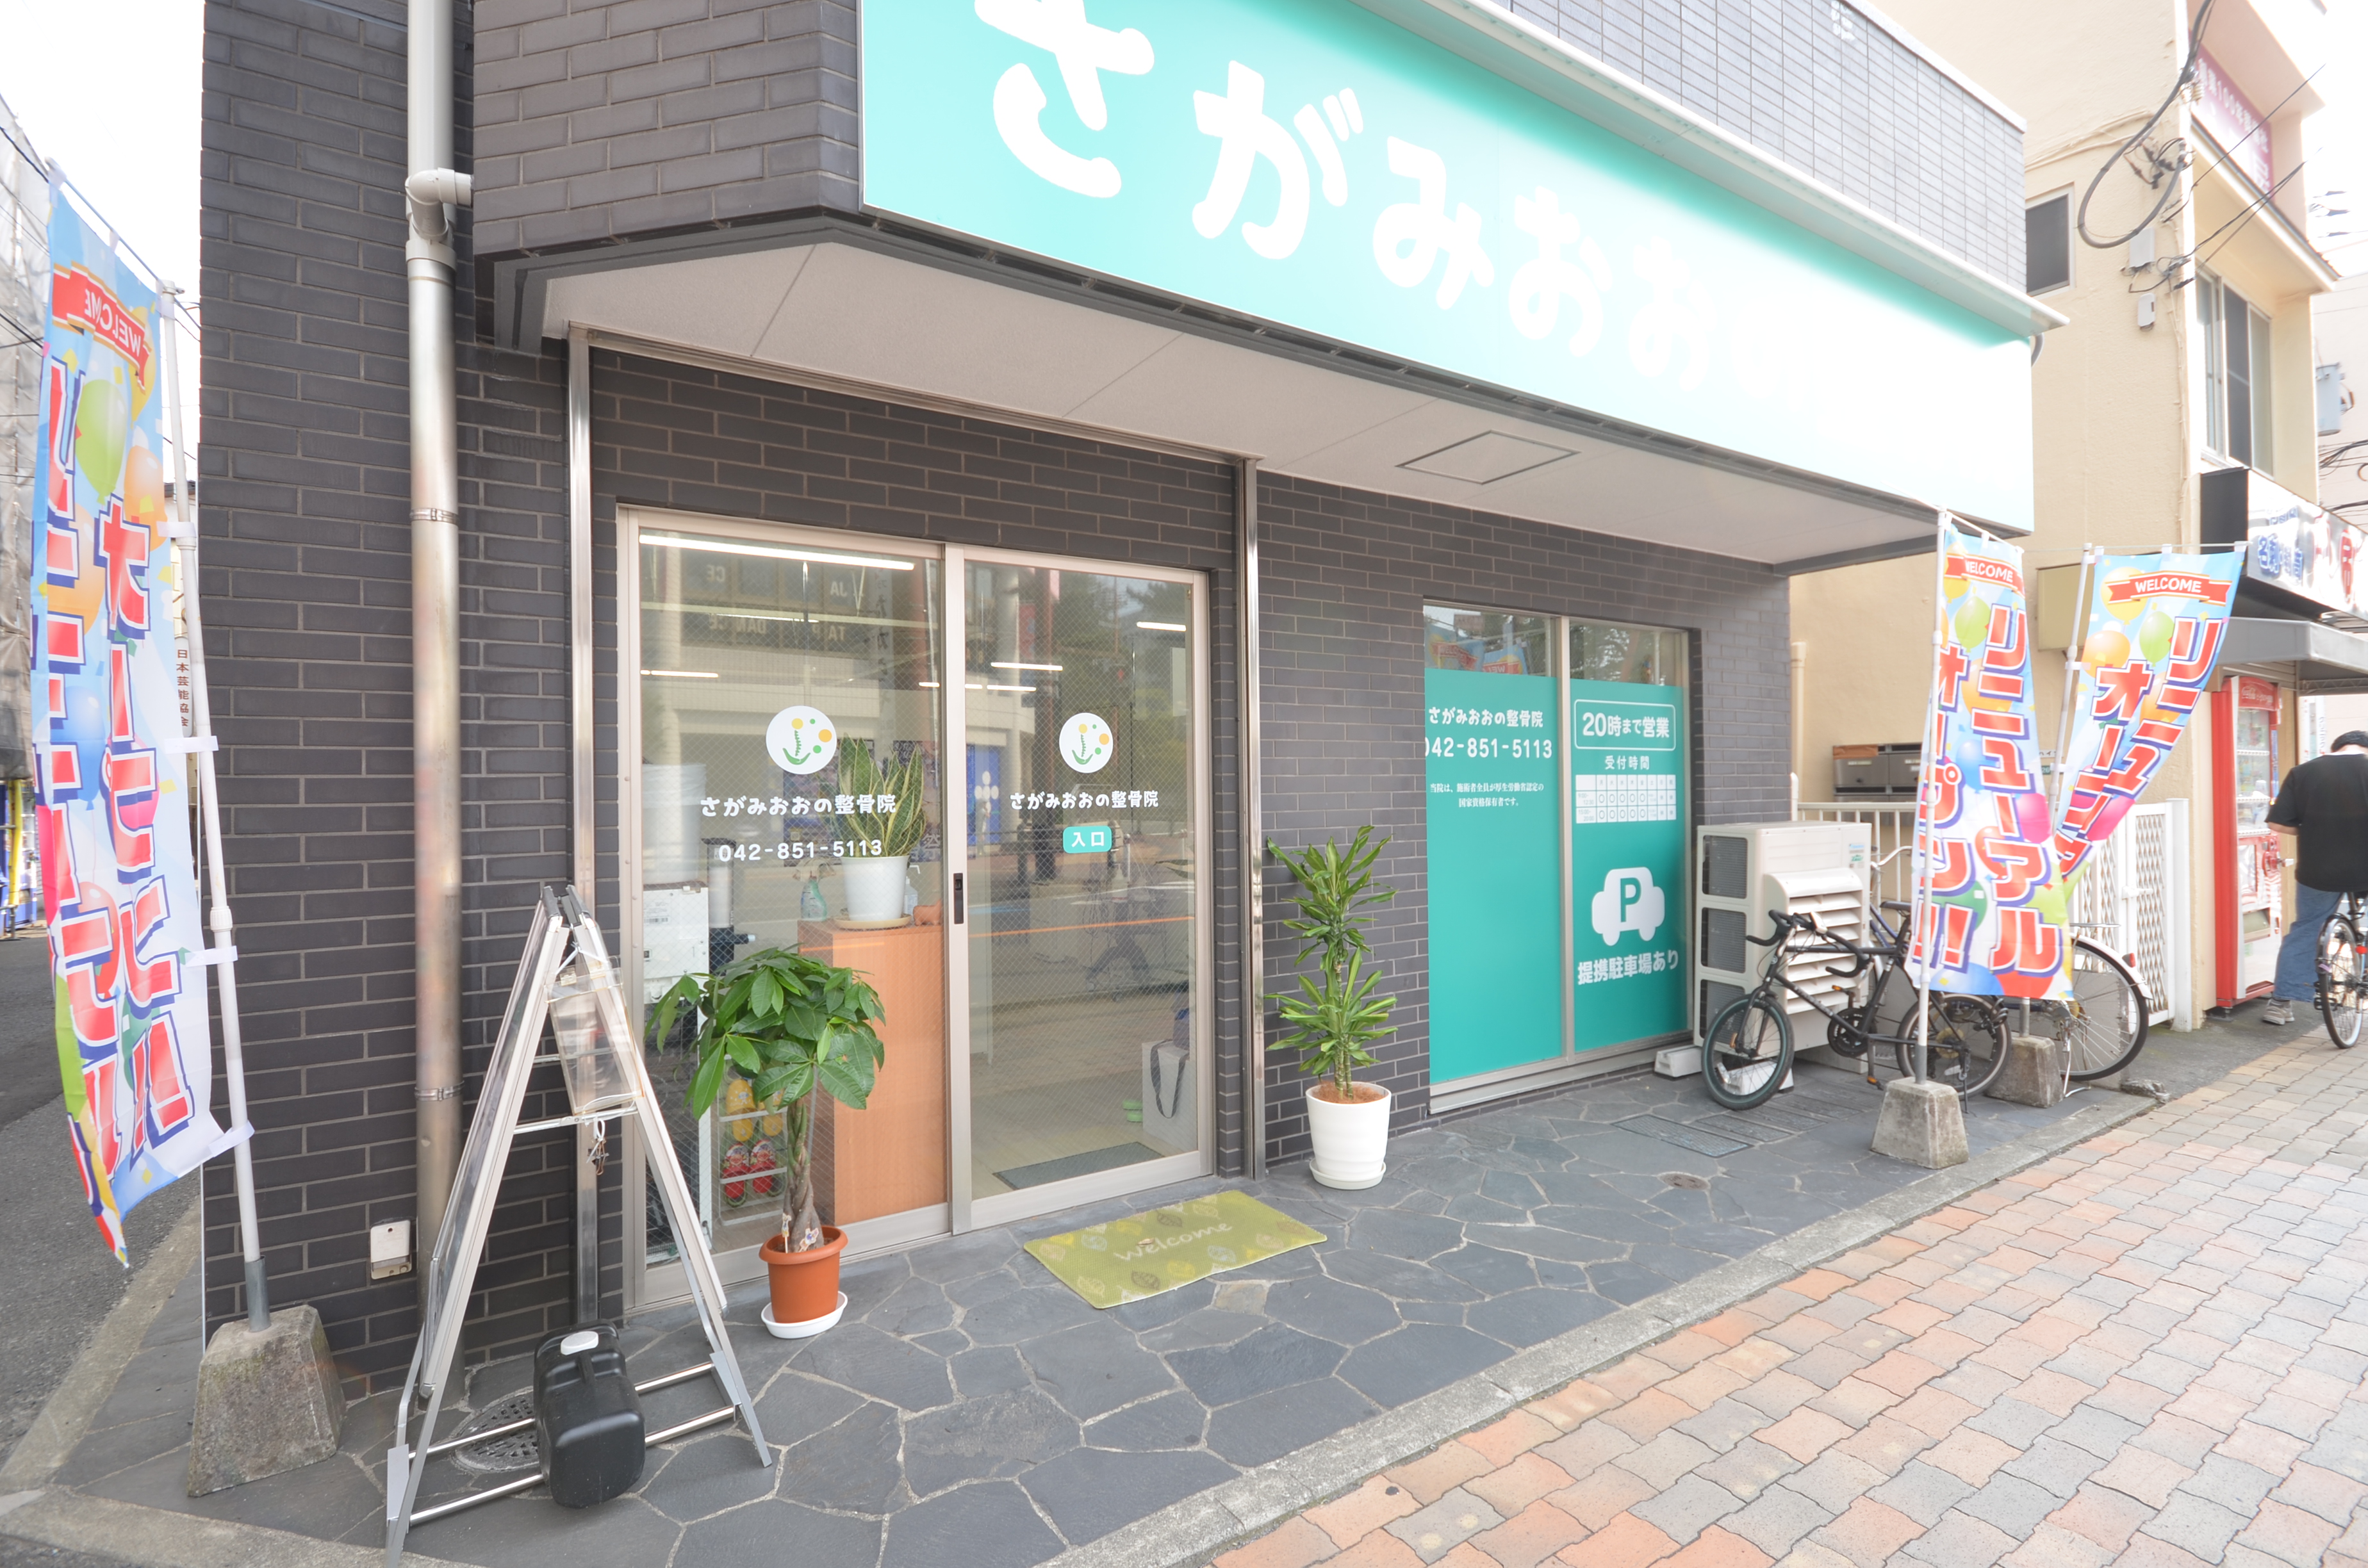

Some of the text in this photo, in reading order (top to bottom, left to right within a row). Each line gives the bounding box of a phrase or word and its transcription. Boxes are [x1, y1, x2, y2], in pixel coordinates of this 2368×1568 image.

[974, 0, 2015, 491] さがみおおの
[1964, 560, 2013, 583] WELCOME
[2135, 576, 2202, 593] WELCOME
[1428, 706, 1543, 728] さがみおおの整骨院
[1583, 712, 1670, 738] 20時まで営業
[1605, 755, 1650, 770] 受付時間
[1971, 603, 2062, 974] リニューアル
[700, 794, 896, 817] さがみおおの整骨院
[1010, 790, 1158, 810] さがみおおの整骨院
[1458, 797, 1519, 808] 国家資格保有者です。
[1071, 831, 1105, 847] 入口
[719, 840, 882, 862] 042-851-5113
[1620, 877, 1641, 922] P
[1577, 949, 1679, 985] 提携駐車場あり
